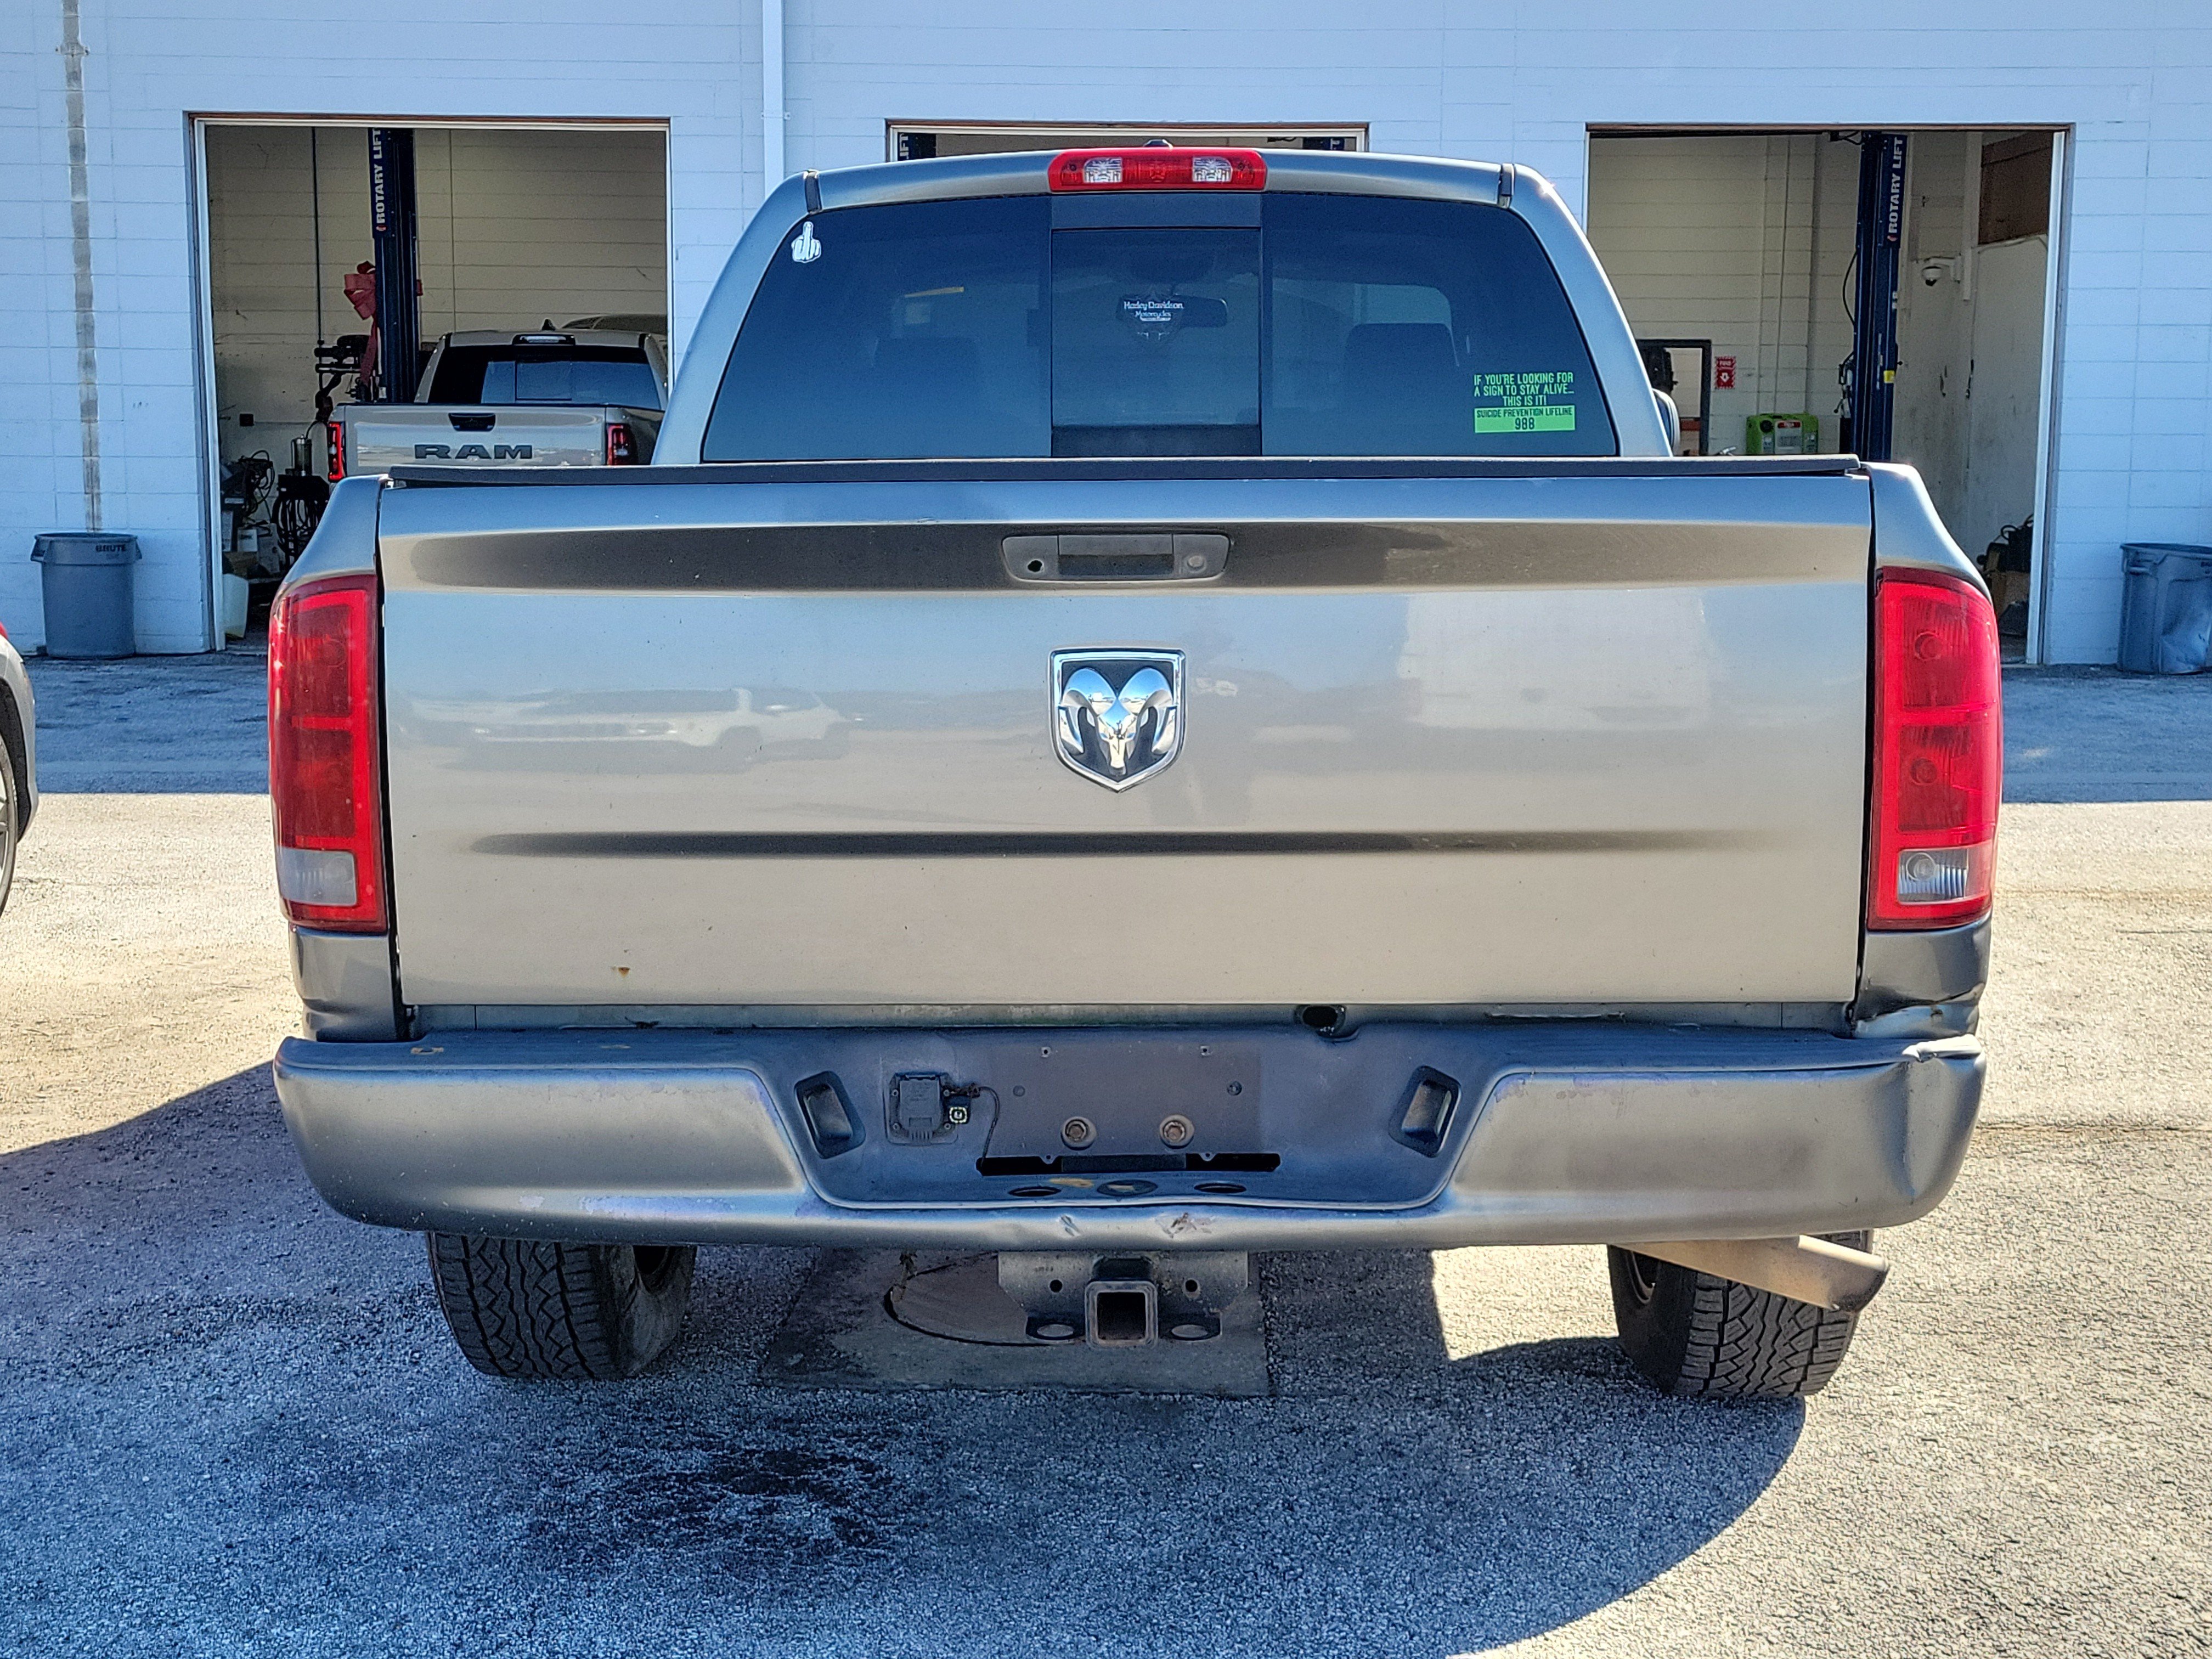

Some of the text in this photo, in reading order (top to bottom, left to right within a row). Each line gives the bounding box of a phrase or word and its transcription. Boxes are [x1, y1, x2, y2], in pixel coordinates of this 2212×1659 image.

[373, 128, 385, 224] ROTARY LIFT
[1888, 137, 1903, 233] ROTARY LIFT
[1474, 372, 1574, 386] IF YOU'RE LOOKING FOR
[1474, 386, 1481, 397] A
[1483, 385, 1503, 396] SIGN
[1505, 385, 1517, 395] TO
[1520, 384, 1541, 395] STAY
[1502, 394, 1547, 407] THIS IS IT!
[1476, 407, 1572, 418] SUICIDE PREVENTION LIFELINE
[1515, 417, 1535, 430] 988
[414, 444, 533, 460] RAM
